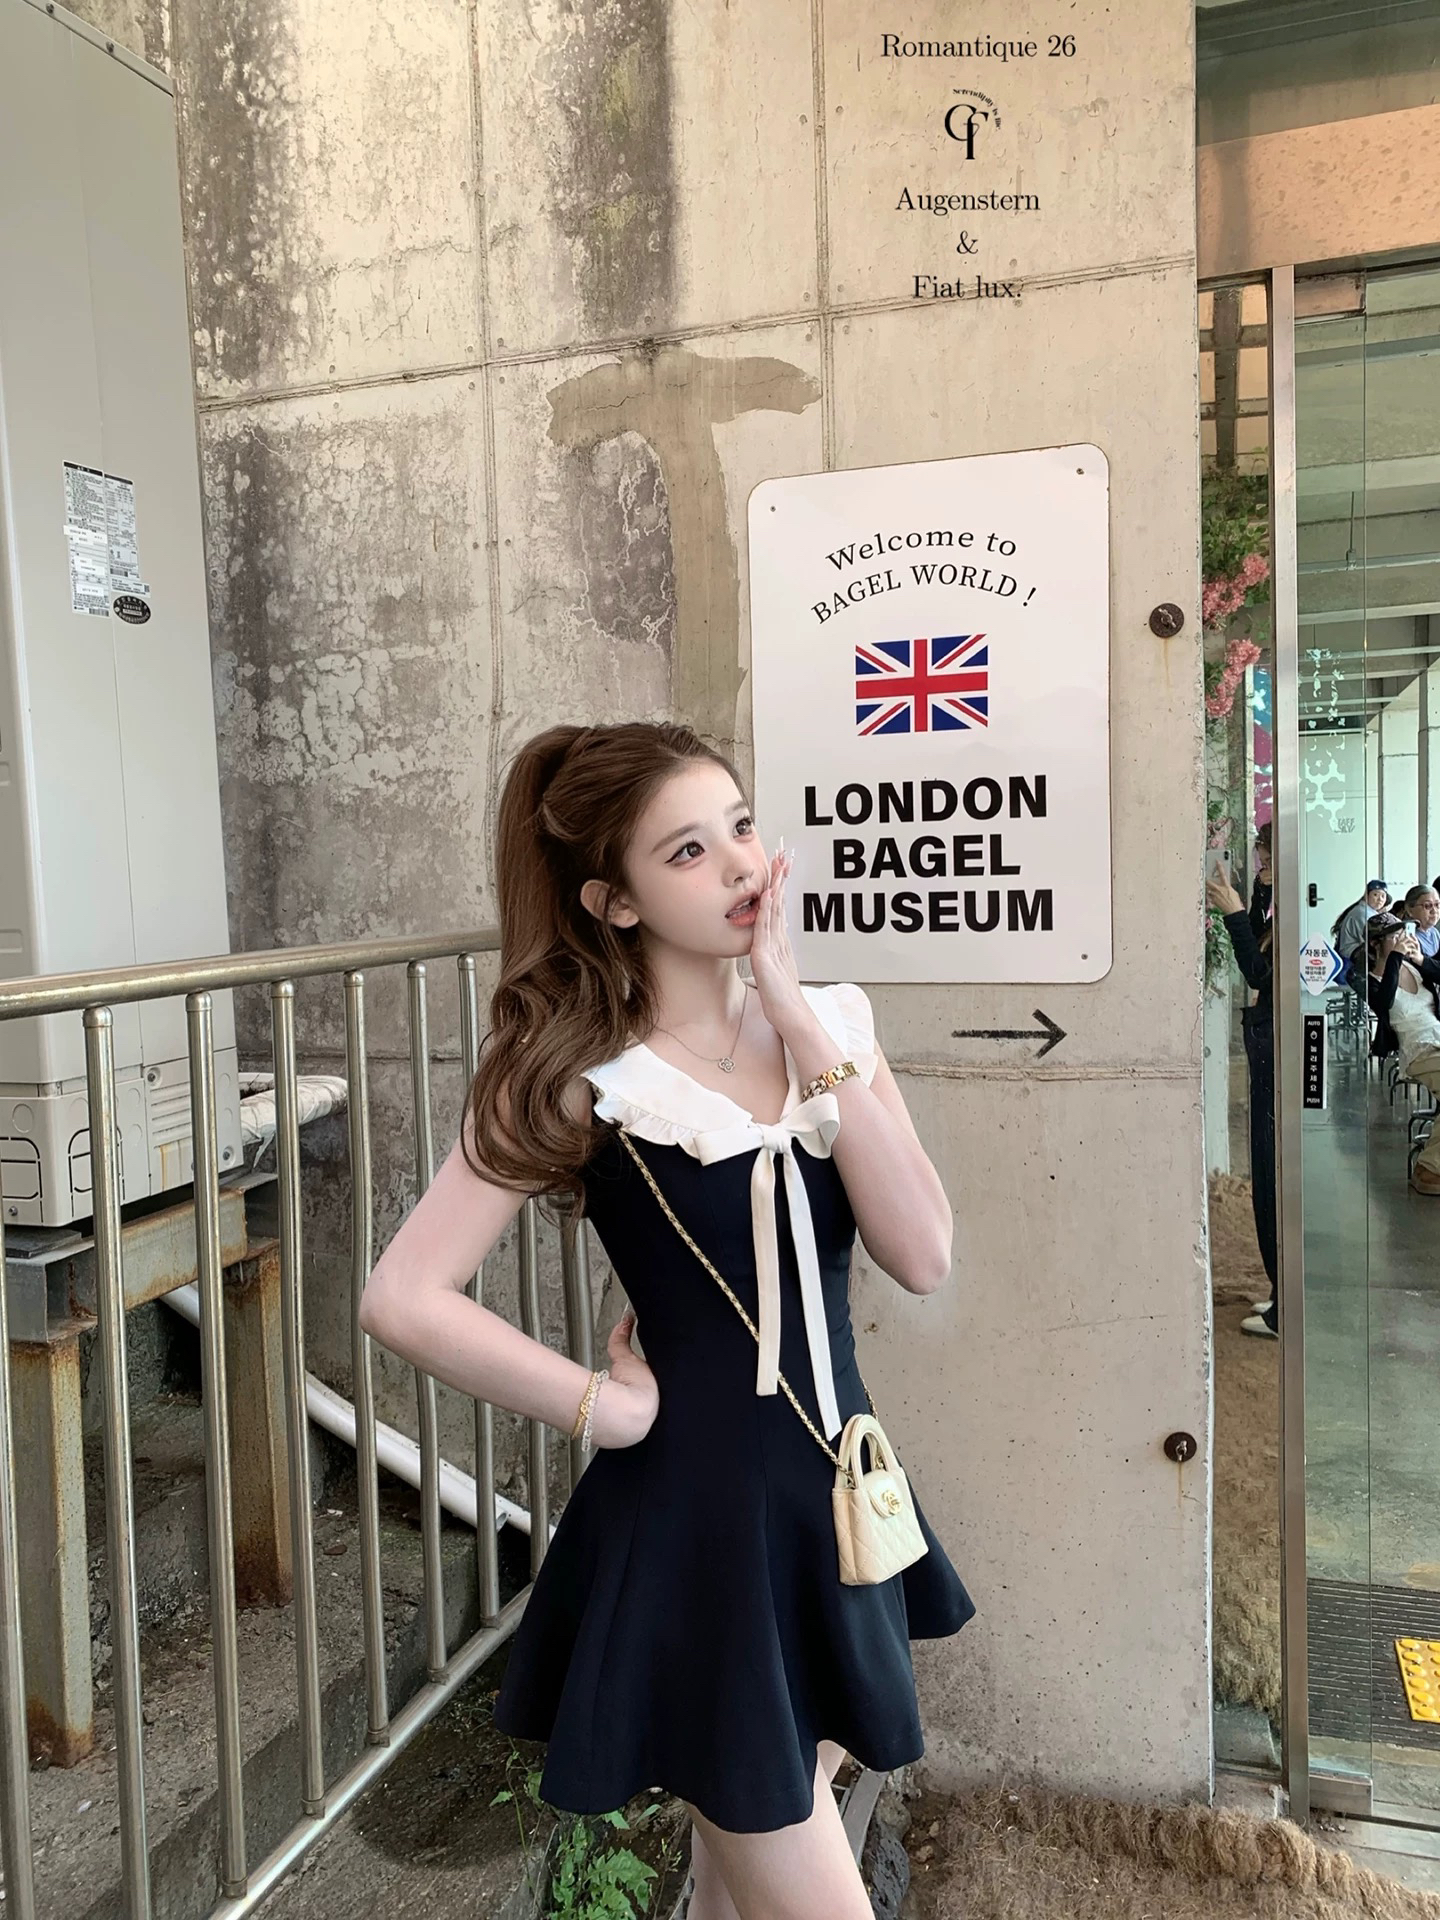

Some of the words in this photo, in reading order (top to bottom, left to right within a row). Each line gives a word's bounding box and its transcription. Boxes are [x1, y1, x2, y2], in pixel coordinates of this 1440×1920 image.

[825, 531, 974, 572] Welcome
[987, 532, 1018, 557] to
[810, 569, 902, 625] BAGEL
[909, 563, 1018, 599] WORLD
[804, 774, 1047, 827] LONDON
[833, 833, 1021, 880] BAGEL
[803, 888, 1054, 934] MUSEUM
[1305, 949, 1328, 957] 자동문
